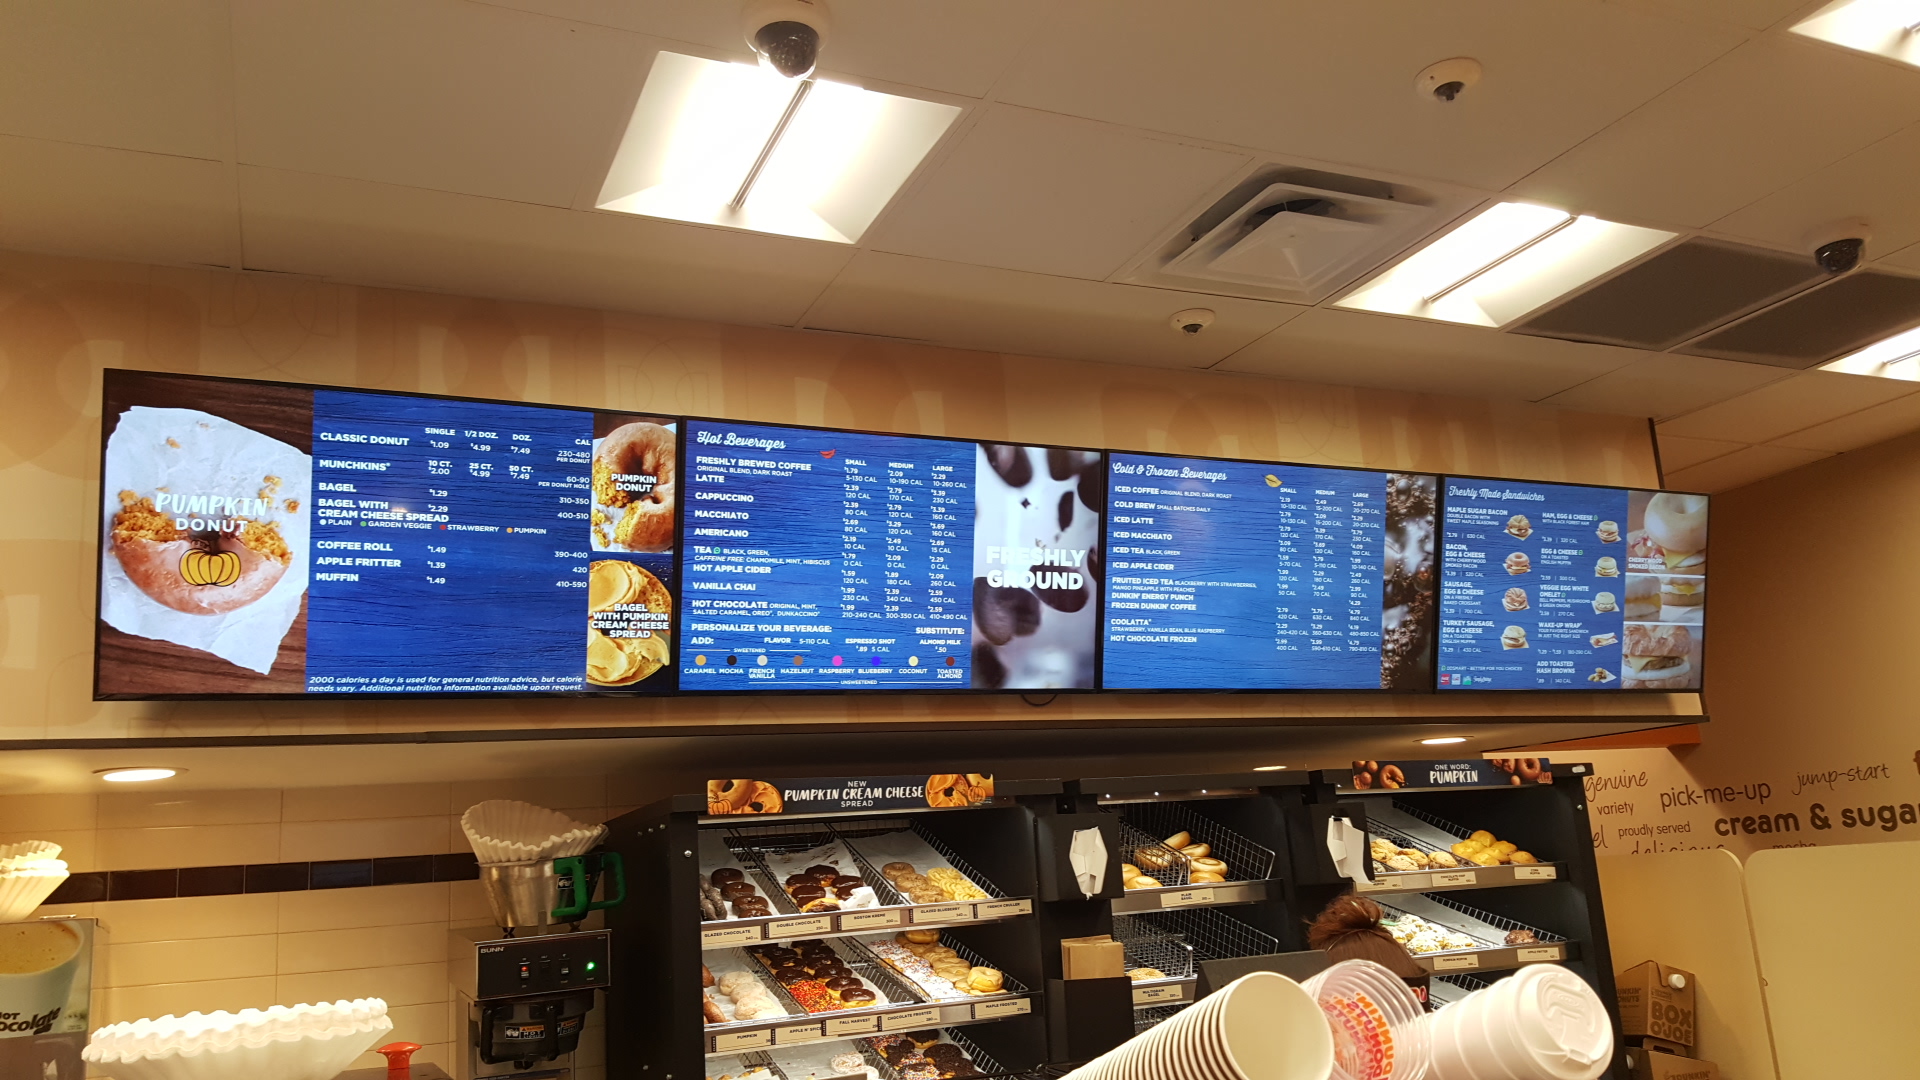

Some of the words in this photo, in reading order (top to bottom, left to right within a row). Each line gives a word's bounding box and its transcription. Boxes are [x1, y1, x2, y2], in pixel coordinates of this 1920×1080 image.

[425, 427, 455, 436] SINGLE
[479, 431, 498, 439] DOZ.
[320, 433, 368, 443] CLASSIC
[370, 435, 409, 445] DONUT
[697, 431, 722, 445] Hot
[724, 432, 786, 451] Beverages
[430, 440, 449, 449] $1.09
[470, 443, 491, 452] $4.99
[511, 446, 530, 454] $7.49
[558, 450, 590, 458] 230-480
[696, 456, 736, 466] FRESHLY
[738, 458, 777, 469] BREWED
[779, 461, 811, 471] COFFEE
[697, 465, 728, 473] ORIGINAL
[729, 467, 751, 475] BLEND,
[1112, 462, 1136, 475] Cold
[1137, 464, 1144, 475] &
[1146, 464, 1179, 478] Frozen
[1180, 467, 1227, 482] Beverages
[566, 476, 590, 484] 60-90
[611, 473, 657, 483] PUMPKIN
[695, 474, 725, 483] LATTE
[319, 482, 357, 492] BAGEL
[616, 482, 652, 492] DONUT
[1132, 486, 1159, 495] COFFEE
[429, 489, 448, 497] $1.29
[695, 492, 754, 502] CAPPUCCINO
[1449, 486, 1478, 500] Freshly
[1479, 489, 1501, 499] Made
[1502, 490, 1545, 501] Sandwiches
[155, 492, 268, 516] PUMPKIN
[318, 499, 356, 509] BAGEL
[358, 501, 388, 510] WITH
[428, 504, 448, 512] $2.29
[1114, 501, 1133, 509] COLD
[1134, 502, 1156, 510] BREW
[318, 509, 358, 519] CREAM
[360, 511, 403, 521] CHEESE
[406, 512, 449, 522] SPREAD
[695, 510, 749, 520] MACCHIATO
[176, 518, 248, 532] DONUT
[368, 520, 402, 528] GARDEN
[448, 524, 499, 532] STRAWBERRY
[694, 528, 749, 537] AMERICANO
[1131, 532, 1172, 541] MACCHIATO
[317, 541, 362, 550] COFFEE
[363, 542, 393, 552] ROLL
[694, 546, 712, 554] TEA
[554, 551, 588, 559] 390-400
[986, 545, 1086, 567] FRESHLY
[316, 557, 353, 566] APPLE
[355, 558, 401, 567] FRITTER
[693, 565, 713, 573] HOT
[714, 565, 743, 573] APPLE
[745, 565, 771, 574] CIDER
[1151, 563, 1174, 571] CIDER
[316, 573, 359, 582] MUFFIN
[426, 576, 445, 584] $1.49
[987, 569, 1083, 590] GROUND
[556, 581, 587, 589] 410-590
[692, 582, 732, 591] VANILLA
[734, 583, 756, 591] CHAI
[614, 603, 648, 612] BAGEL
[692, 600, 711, 608] HOT
[713, 600, 768, 609] CHOCOLATE
[592, 612, 621, 620] WITH
[622, 613, 668, 621] PUMPKIN
[591, 621, 628, 629] CREAM
[629, 621, 669, 630] CHEESE
[691, 624, 755, 632] PERSONALIZE
[757, 624, 782, 632] YOUR
[609, 630, 651, 638] SPREAD
[915, 627, 965, 635] SUBSTITUTE:
[691, 637, 714, 645] ADD:
[1127, 635, 1167, 643] CHOCOLATE
[336, 676, 370, 684] calories
[378, 676, 395, 685] day
[442, 676, 473, 685] general
[511, 676, 539, 684] advice,
[1430, 770, 1478, 784] PUMPKIN
[1791, 763, 1890, 795] jump-start
[1585, 770, 1648, 802] genuine
[784, 788, 840, 802] PUMPKIN
[842, 788, 883, 800] CREAM
[886, 786, 924, 798] CHEESE
[1660, 782, 1771, 813] pick-me-up
[841, 800, 874, 808] SPREAD
[1597, 802, 1634, 816] variety
[1714, 812, 1800, 837] cream
[1809, 803, 1832, 831] &
[1841, 802, 1920, 832] suga
[1618, 824, 1653, 840] proudly
[1657, 821, 1691, 834] served
[887, 1013, 912, 1021] CHOCOLATE
[1651, 1000, 1691, 1029] BOX
[1650, 1020, 1691, 1044] O'JOE
